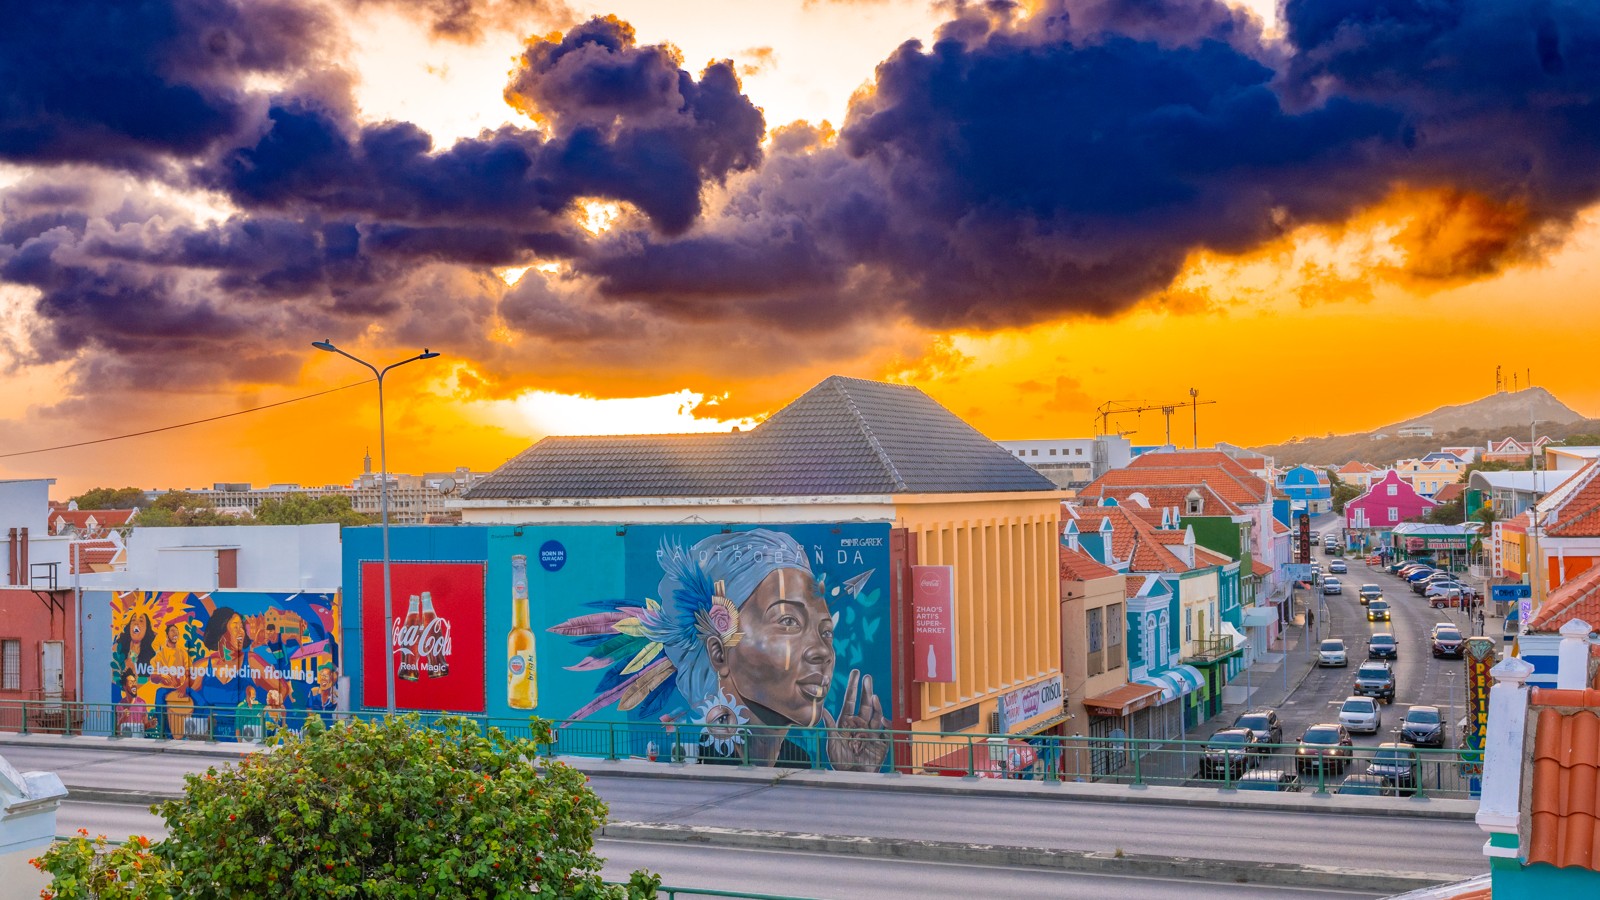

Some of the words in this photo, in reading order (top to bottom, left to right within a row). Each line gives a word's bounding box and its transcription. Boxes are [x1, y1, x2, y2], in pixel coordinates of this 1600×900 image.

[134, 663, 154, 674] We
[157, 664, 185, 678] keep
[189, 666, 217, 680] your
[219, 665, 261, 680] riddim
[263, 666, 318, 684] flowing.
[401, 662, 418, 671] Real
[421, 663, 446, 672] Magic
[1041, 682, 1061, 703] CRISOL
